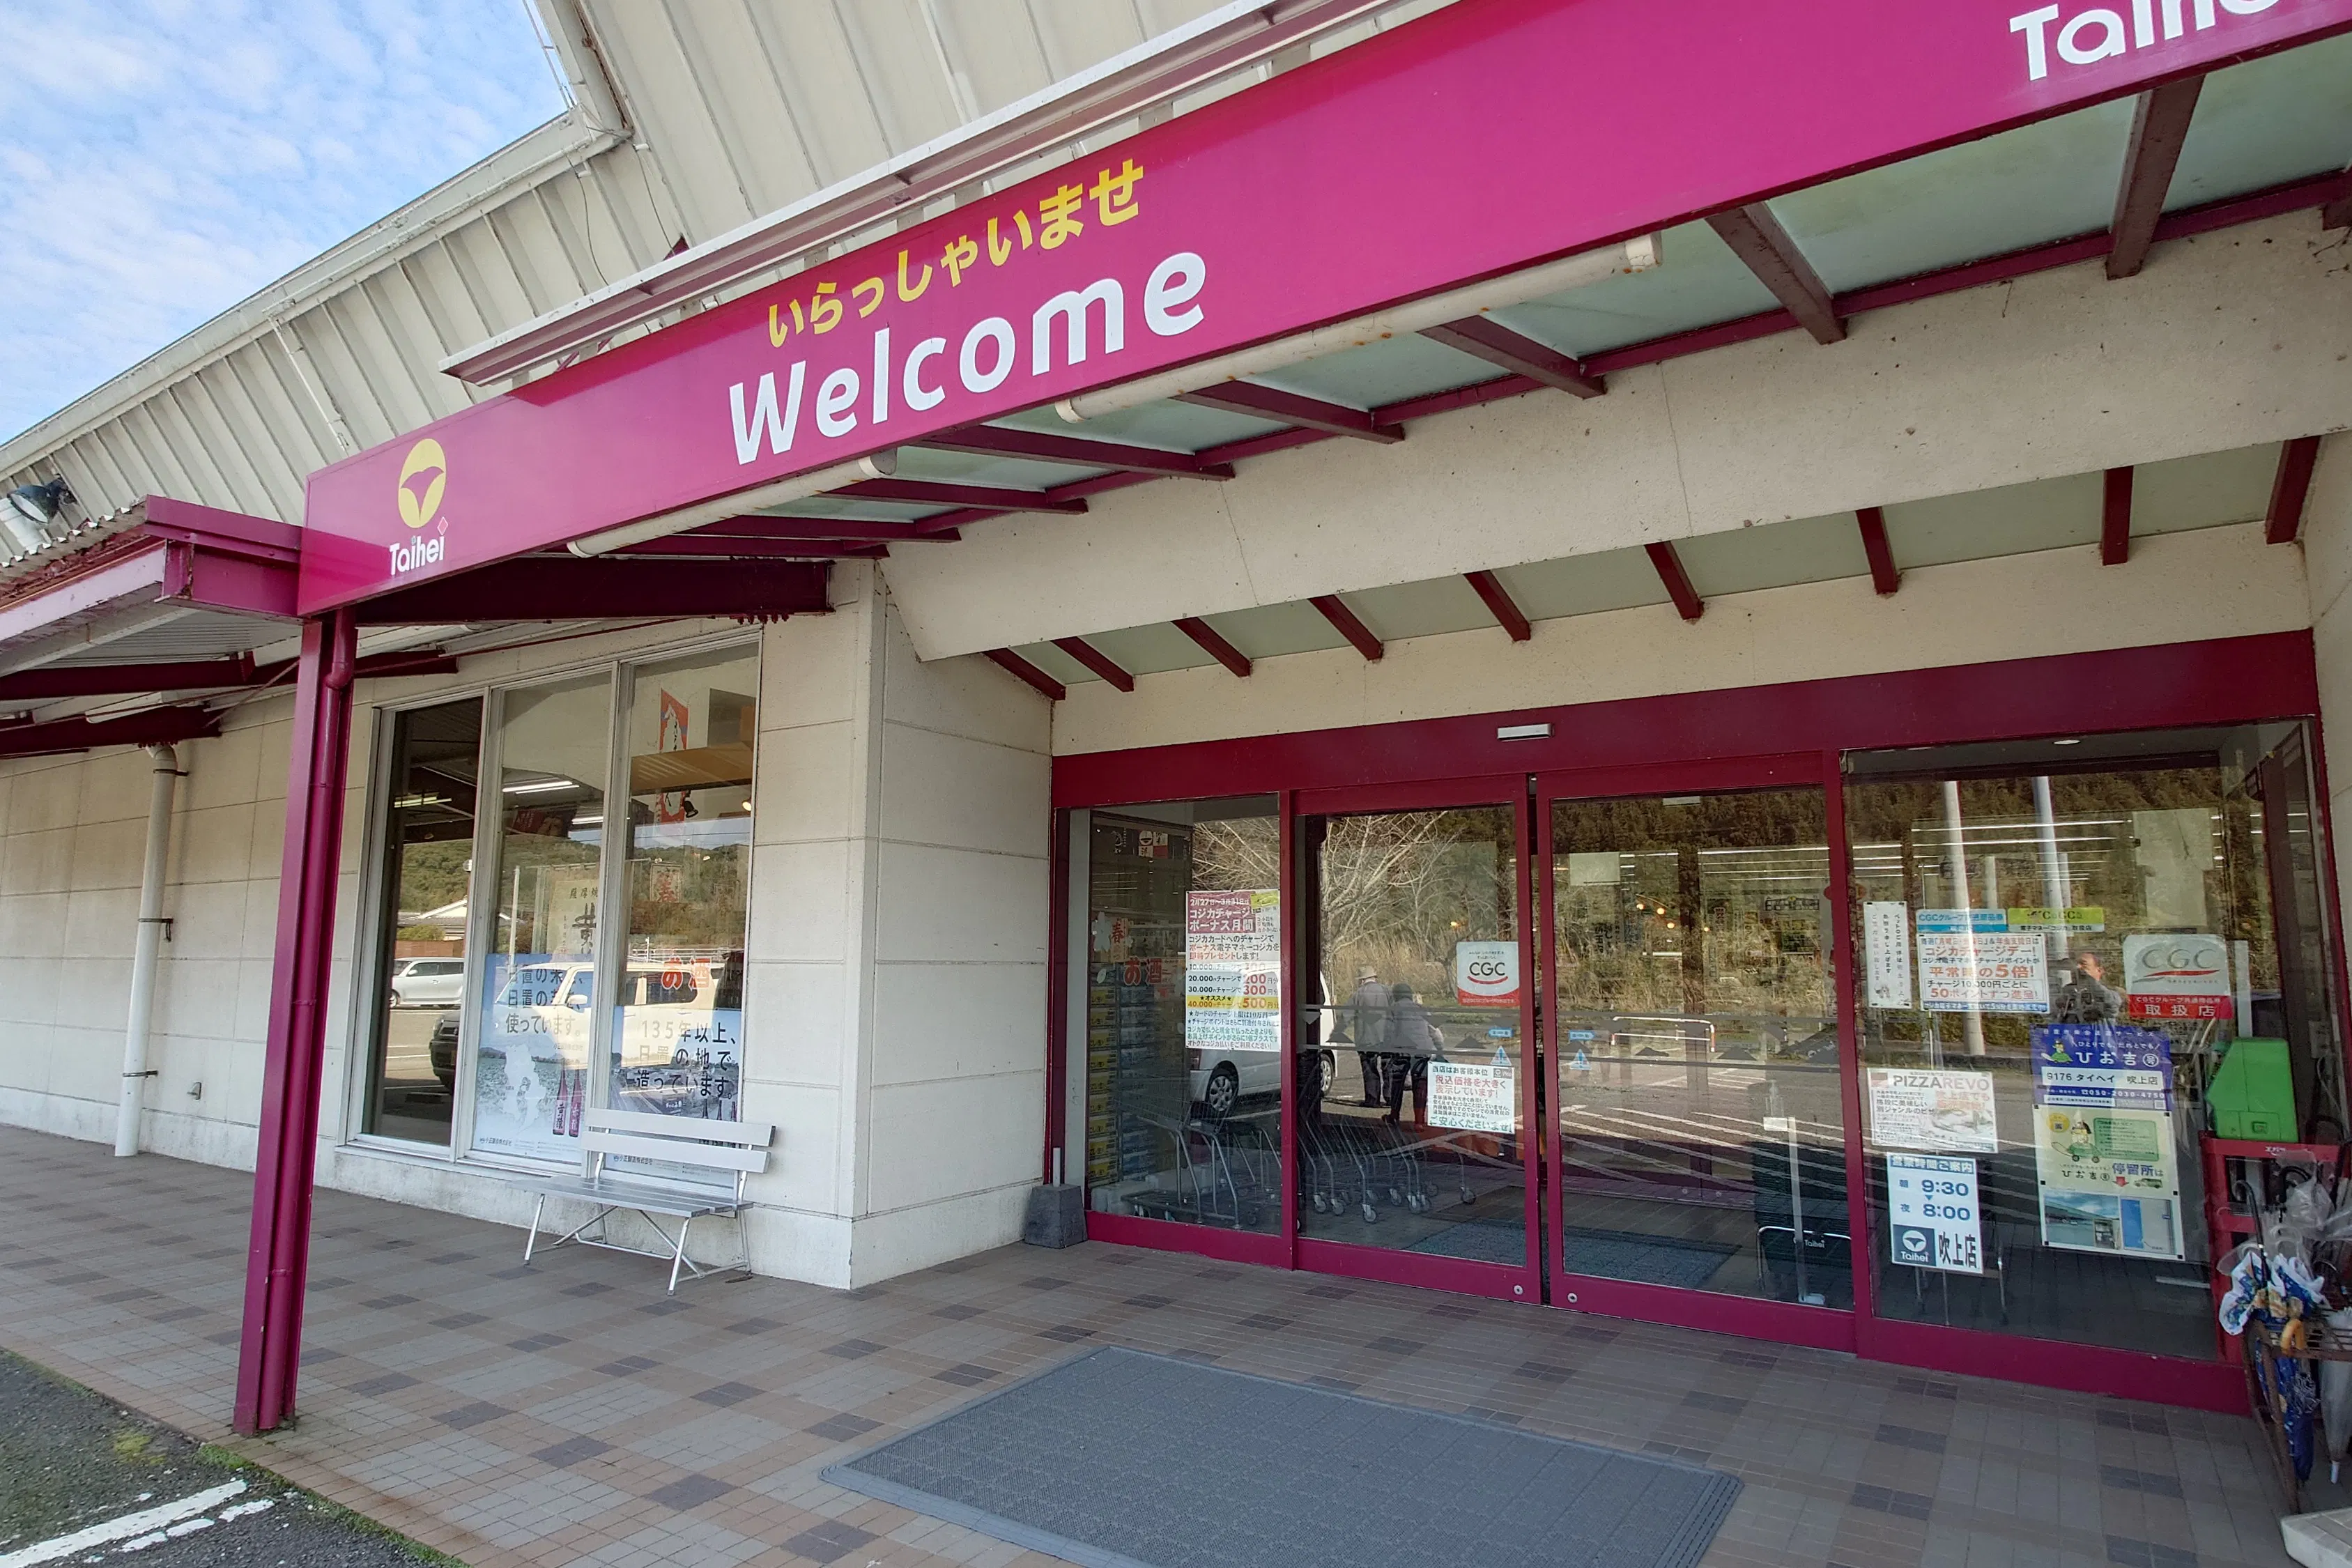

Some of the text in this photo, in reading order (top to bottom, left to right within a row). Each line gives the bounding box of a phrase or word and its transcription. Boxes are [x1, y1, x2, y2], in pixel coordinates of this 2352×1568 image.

[769, 157, 1145, 348] いらっしゃいませ
[728, 252, 1207, 466] Welcome
[390, 532, 445, 575] Taihei
[1190, 908, 1250, 918] コジカチャージ
[1190, 918, 1254, 931] ボーナス月間
[1189, 943, 1279, 951] ボーナス電子マネーコジカを
[2142, 948, 2217, 969] CGC
[661, 958, 711, 990] お酒
[1123, 955, 1162, 986] お酒
[1469, 962, 1506, 976] CGC
[508, 989, 581, 1010] 日置の、
[2145, 1004, 2216, 1017] 取扱店
[506, 1013, 580, 1036] 使っています。
[641, 1020, 737, 1045] 135年以上、
[639, 1045, 733, 1072] 日置の地で
[1433, 1066, 1489, 1076] 当店はお客様本位
[2047, 1073, 2158, 1085] 9176 タイヘイ 吹上店
[636, 1069, 732, 1100] 造っています。
[1436, 1075, 1506, 1089] 税込価格を大きく
[1893, 1075, 1990, 1091] PIZZAREVO
[1891, 1155, 1974, 1174] 営業時間ご案内
[2112, 1162, 2164, 1177] 停留所は
[1921, 1179, 1969, 1197] 9:30
[1900, 1204, 1971, 1221] 夜 8:00
[1900, 1231, 1977, 1268] Taihei 吹上店
